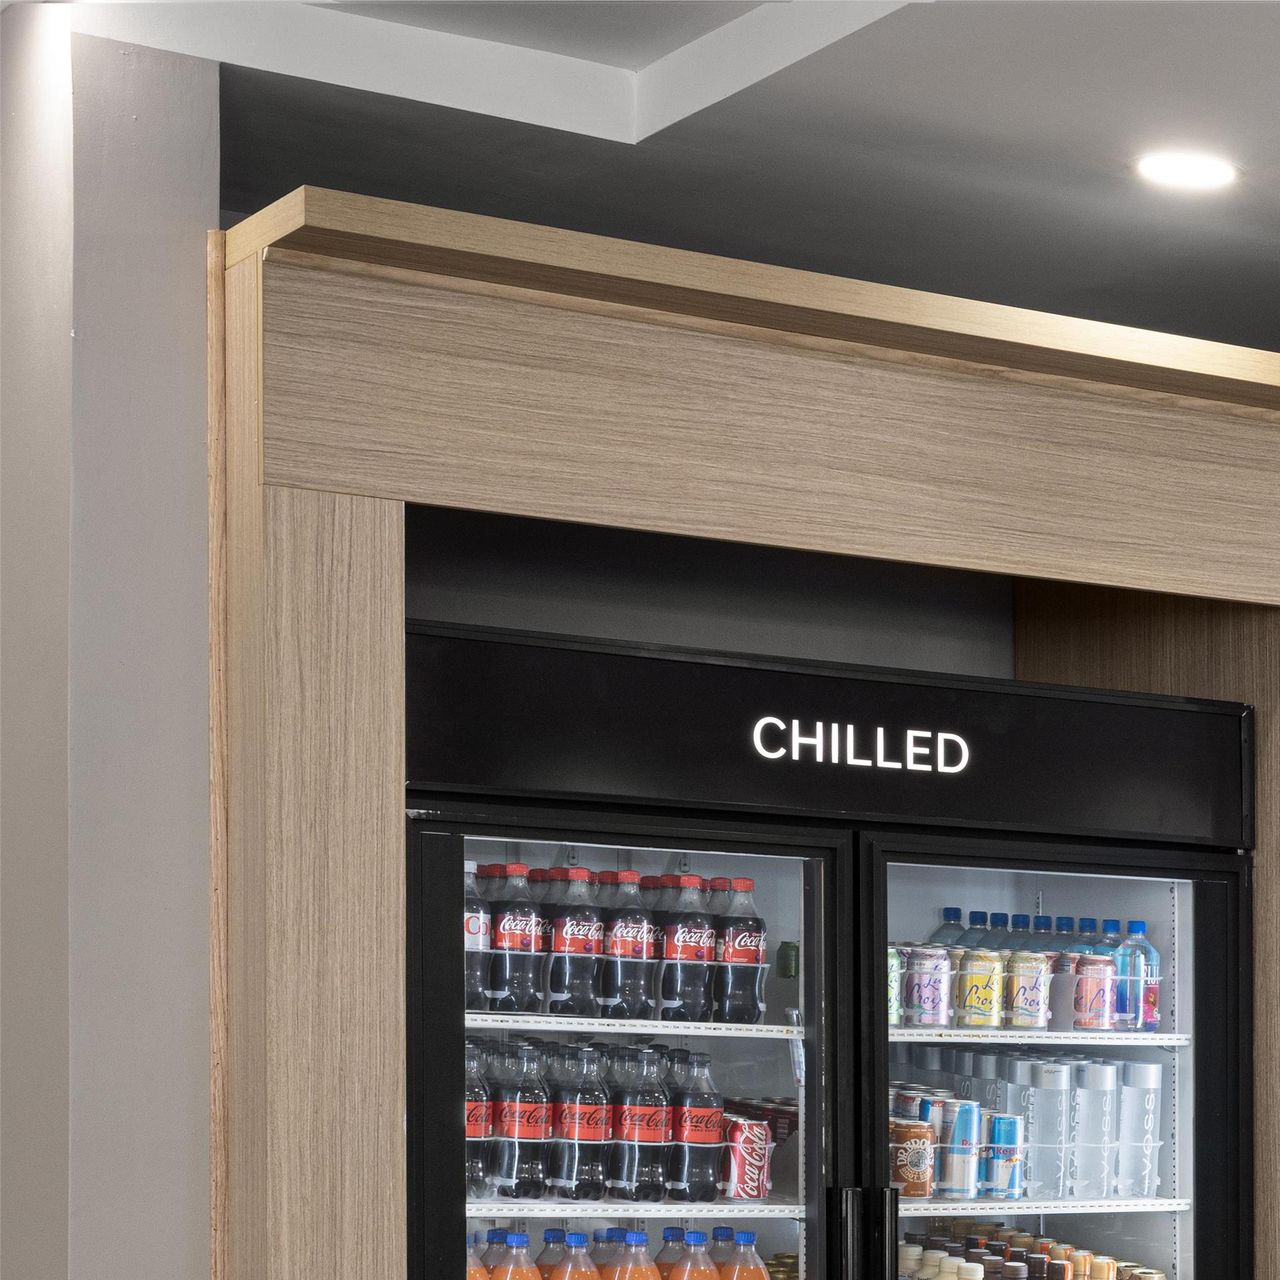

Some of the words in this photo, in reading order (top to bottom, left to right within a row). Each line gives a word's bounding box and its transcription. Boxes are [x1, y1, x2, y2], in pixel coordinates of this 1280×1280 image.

[753, 716, 970, 774] CHILLED
[738, 1122, 767, 1199] Coca-Cola
[1100, 1094, 1112, 1178] VOSS
[1142, 1092, 1155, 1177] VOSS
